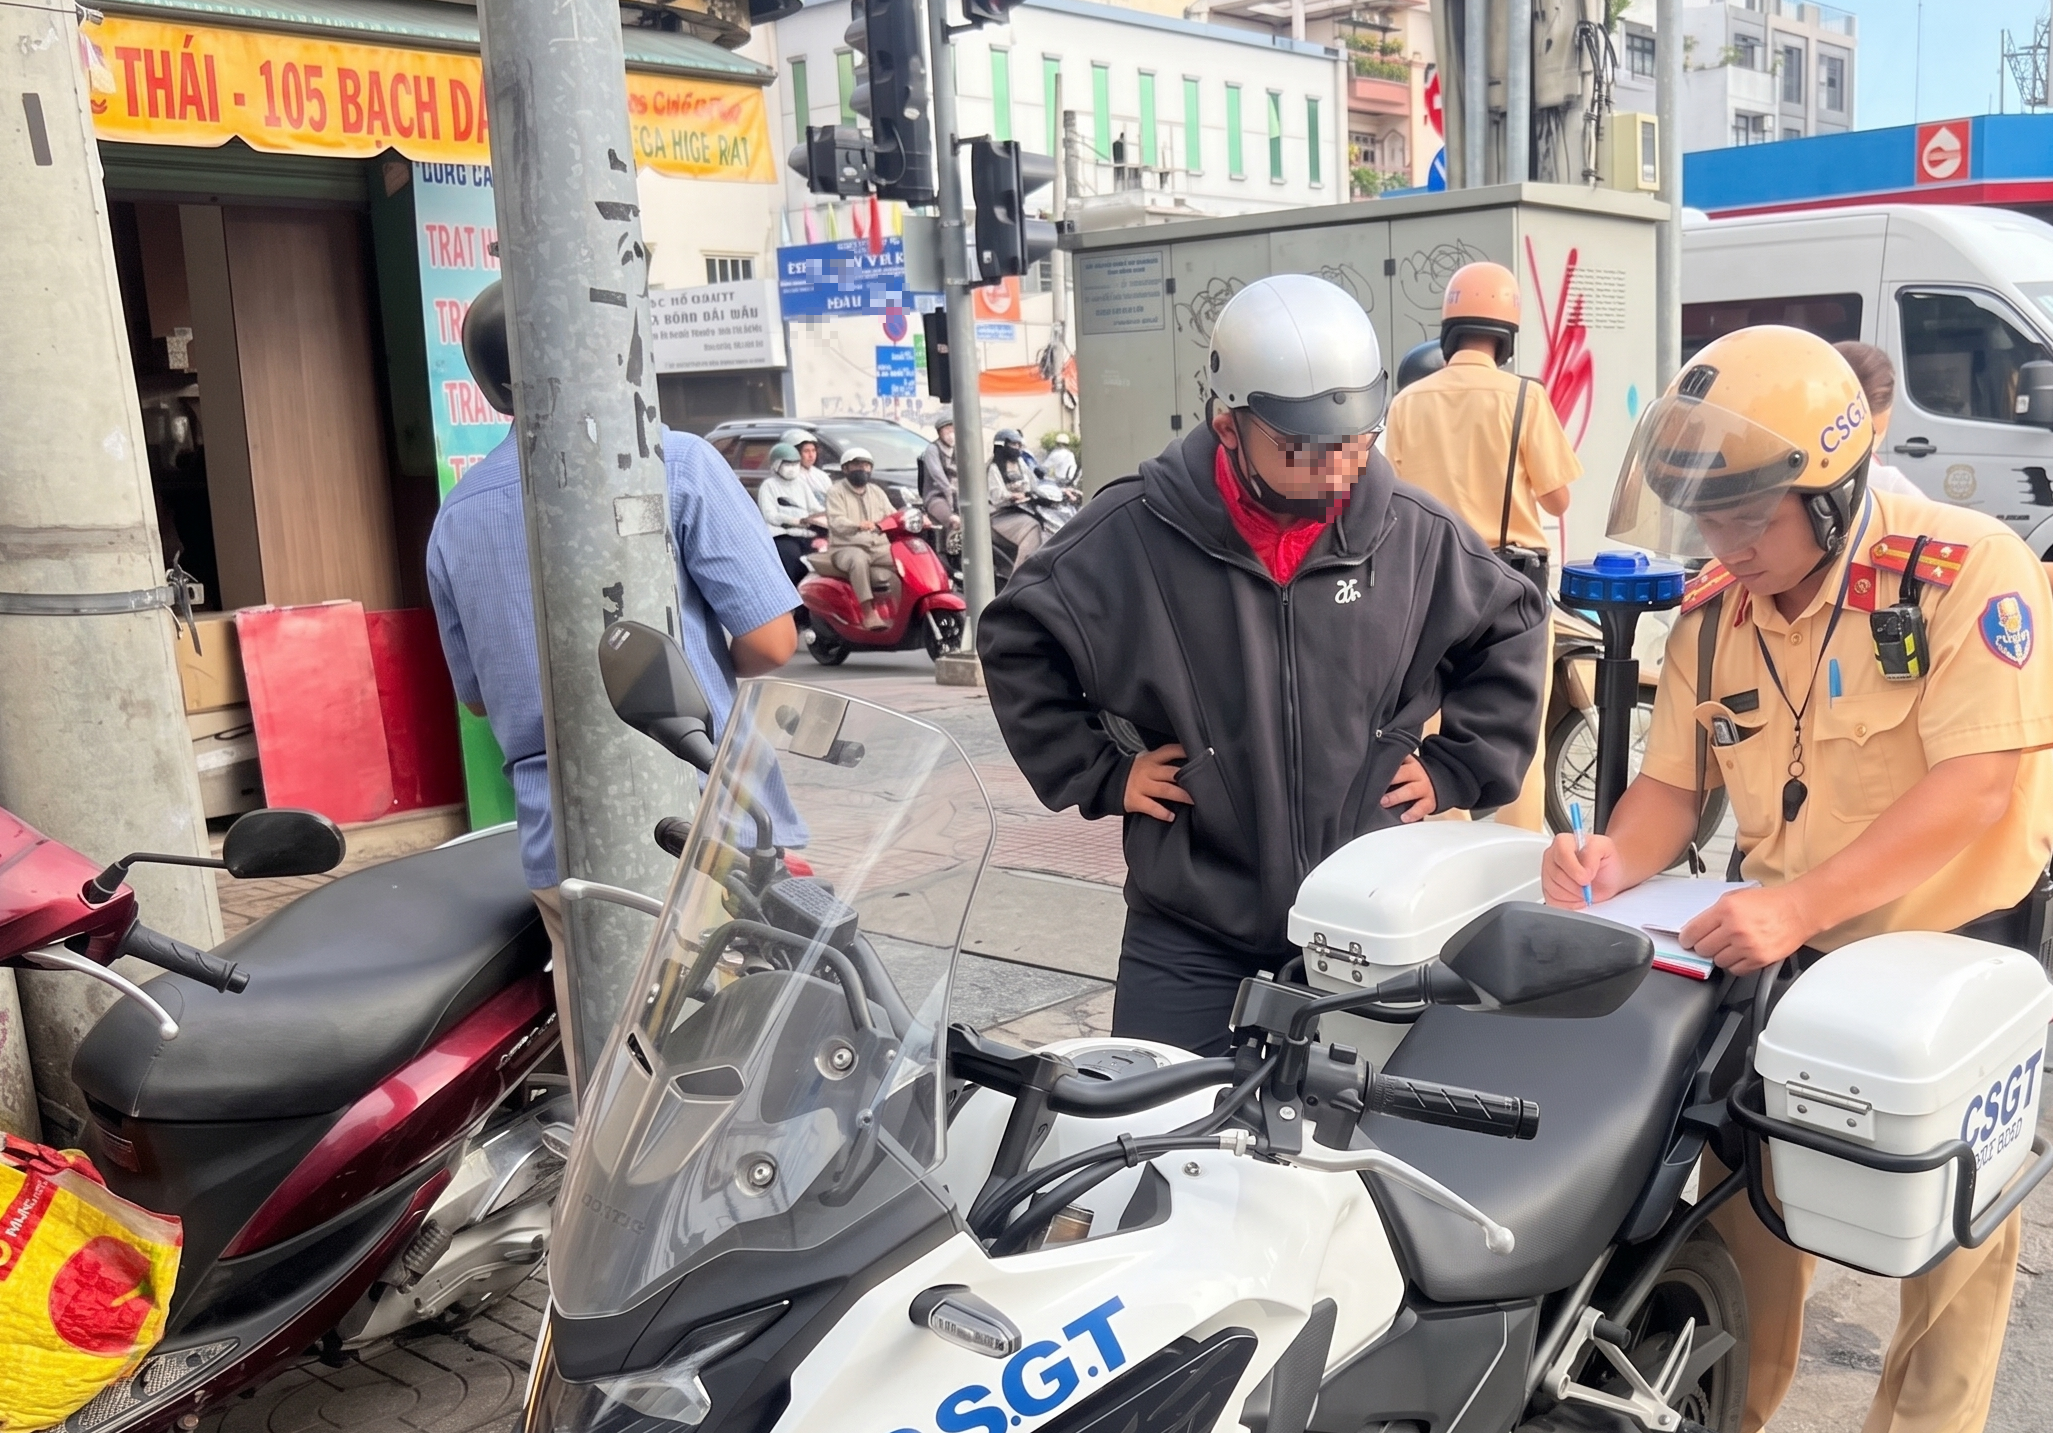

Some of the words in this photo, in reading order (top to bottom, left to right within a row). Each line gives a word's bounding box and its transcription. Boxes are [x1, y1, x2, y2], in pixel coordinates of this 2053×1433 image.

[114, 34, 220, 123] THÁI
[259, 60, 327, 132] 105
[337, 67, 440, 148] BẠCH
[1820, 391, 1867, 453] CSGT
[1960, 1047, 2042, 1149] CSGT
